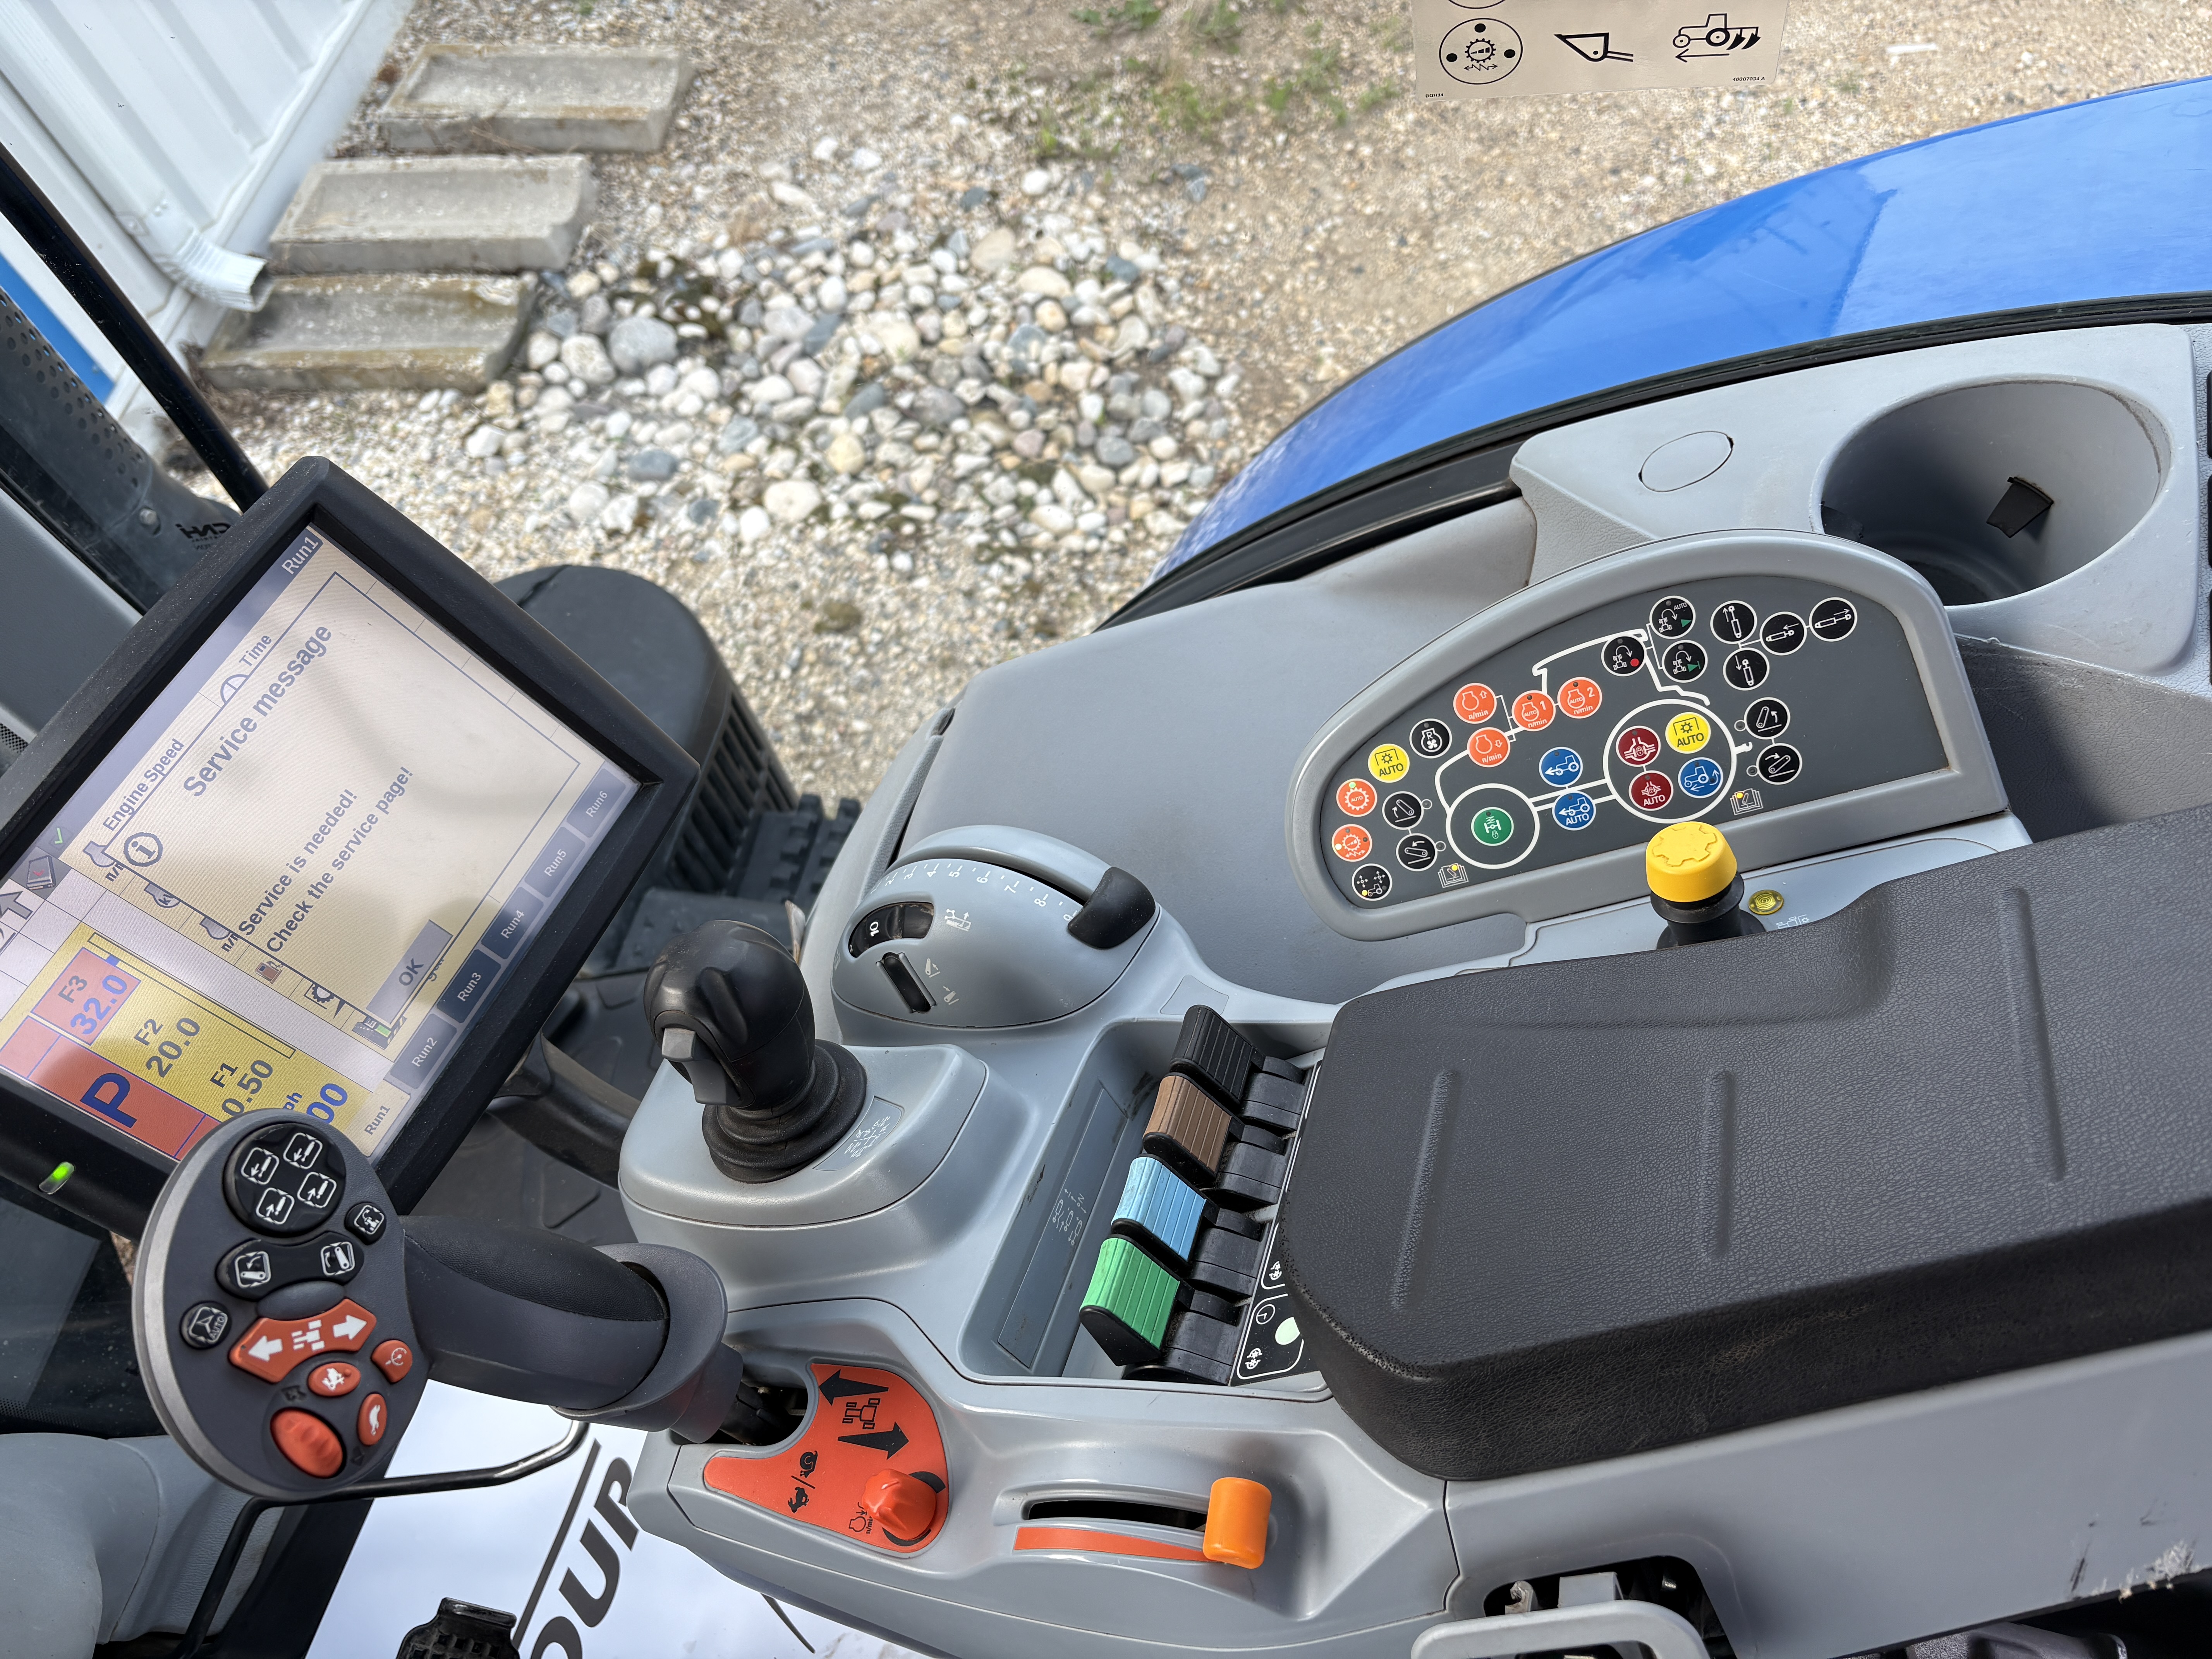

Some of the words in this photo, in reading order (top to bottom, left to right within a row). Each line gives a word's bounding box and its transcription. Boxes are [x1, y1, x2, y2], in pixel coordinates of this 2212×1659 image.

[282, 537, 319, 575] Run1
[1673, 602, 1687, 611] AUTO
[239, 635, 272, 666] Time
[1540, 701, 1546, 711] 1
[1587, 687, 1595, 698] 2
[184, 718, 257, 797] Service
[252, 625, 332, 717] message
[1468, 709, 1489, 720] n/min
[1528, 718, 1547, 728] n/min
[1573, 704, 1593, 715] n/min
[1677, 733, 1704, 747] AUTO
[1379, 763, 1404, 777] AUTO
[1482, 752, 1503, 763] n/min
[103, 783, 149, 831] Engine
[144, 738, 184, 782] Speed
[585, 790, 608, 824] Run6
[1643, 794, 1665, 806] AUTO
[1565, 813, 1589, 825] AUTO
[239, 875, 292, 936] Service
[286, 855, 307, 874] is
[303, 789, 357, 854] needed!
[266, 900, 314, 952] Check
[307, 872, 334, 899] the
[332, 814, 378, 871] service
[375, 766, 413, 815] page!
[543, 848, 567, 877] Run5
[1004, 885, 1016, 893] 7
[1034, 898, 1046, 907] 8
[500, 909, 525, 939] Run4
[870, 921, 879, 937] 10
[398, 958, 424, 986] OK
[57, 975, 88, 1004] F3
[457, 972, 482, 1002] Run3
[70, 974, 127, 1036] 32.0
[134, 1018, 164, 1047] F2
[146, 1017, 201, 1079] 20.0
[411, 1036, 438, 1068] Run2
[210, 1062, 238, 1088] F1
[222, 1060, 273, 1116] 0.50
[79, 1072, 137, 1128] P
[364, 1105, 390, 1135] Run1
[210, 1316, 225, 1340] AUTO
